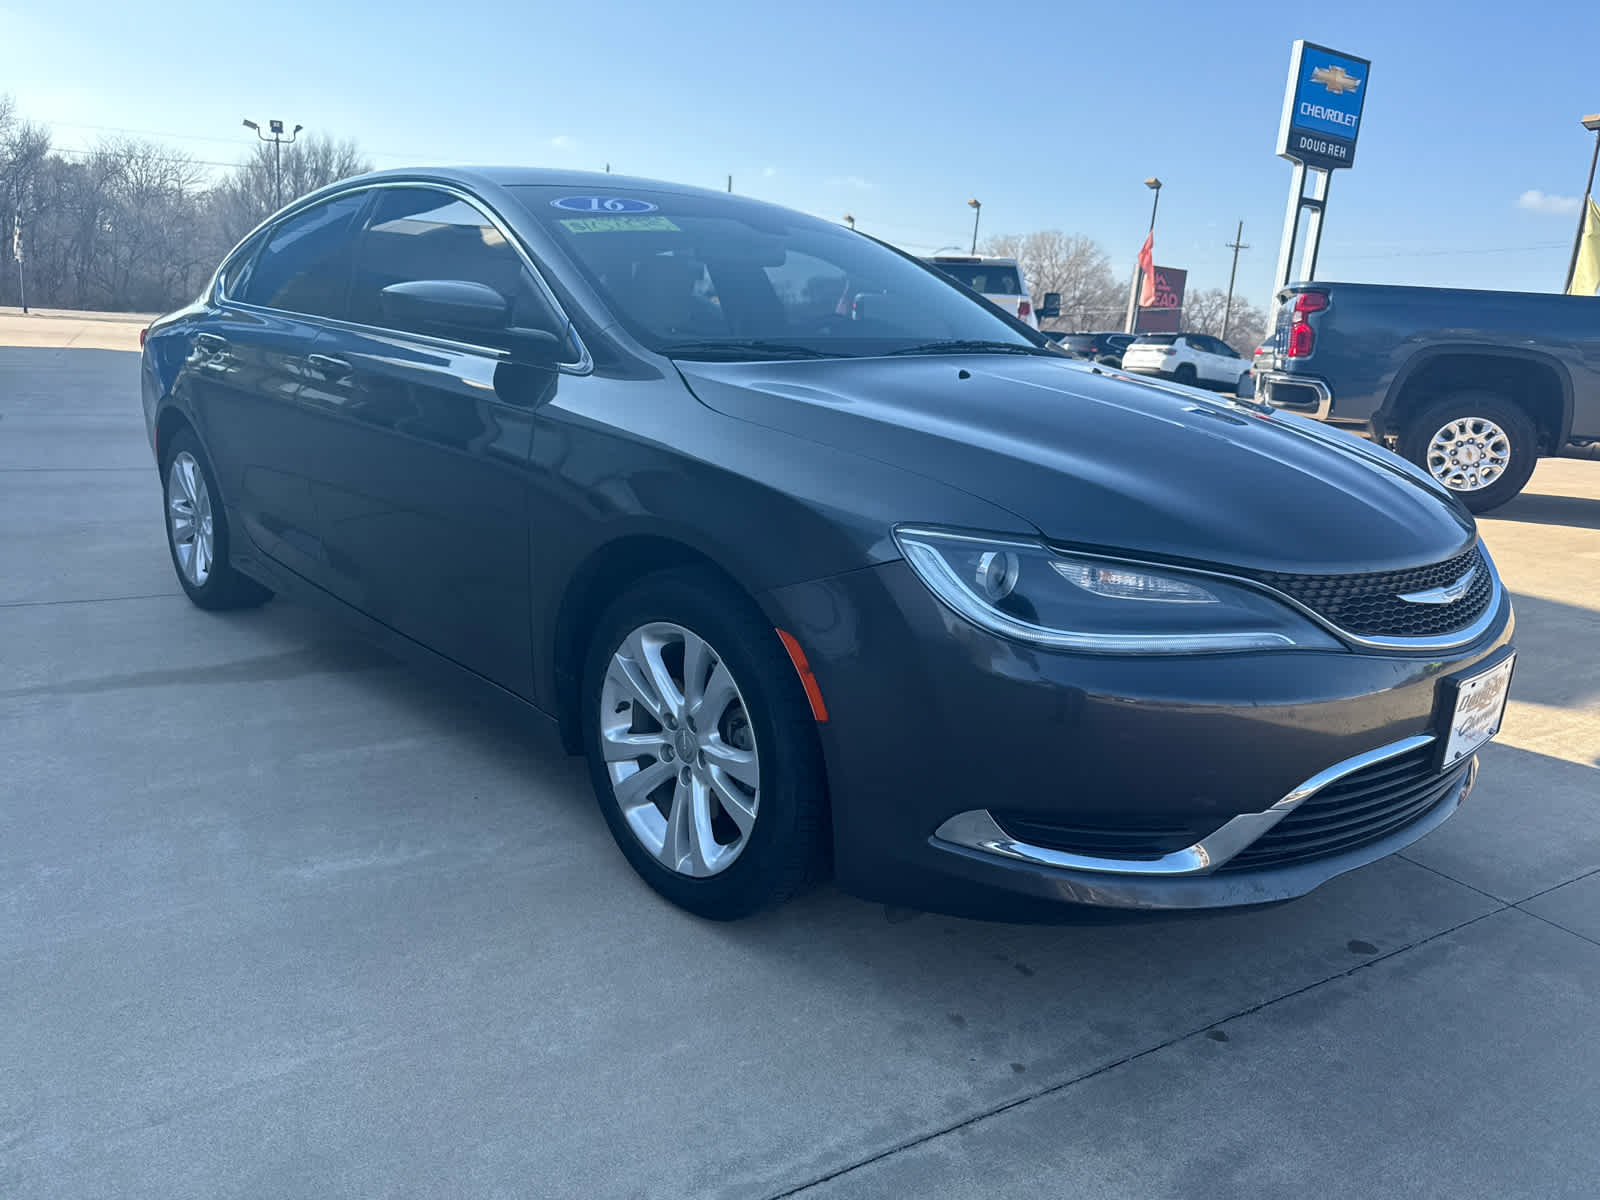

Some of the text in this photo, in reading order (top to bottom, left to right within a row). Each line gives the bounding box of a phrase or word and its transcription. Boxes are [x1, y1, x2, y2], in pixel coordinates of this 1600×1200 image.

[1300, 102, 1358, 127] CHEVROLET
[1300, 137, 1346, 158] DOUG REH
[589, 198, 625, 211] 16
